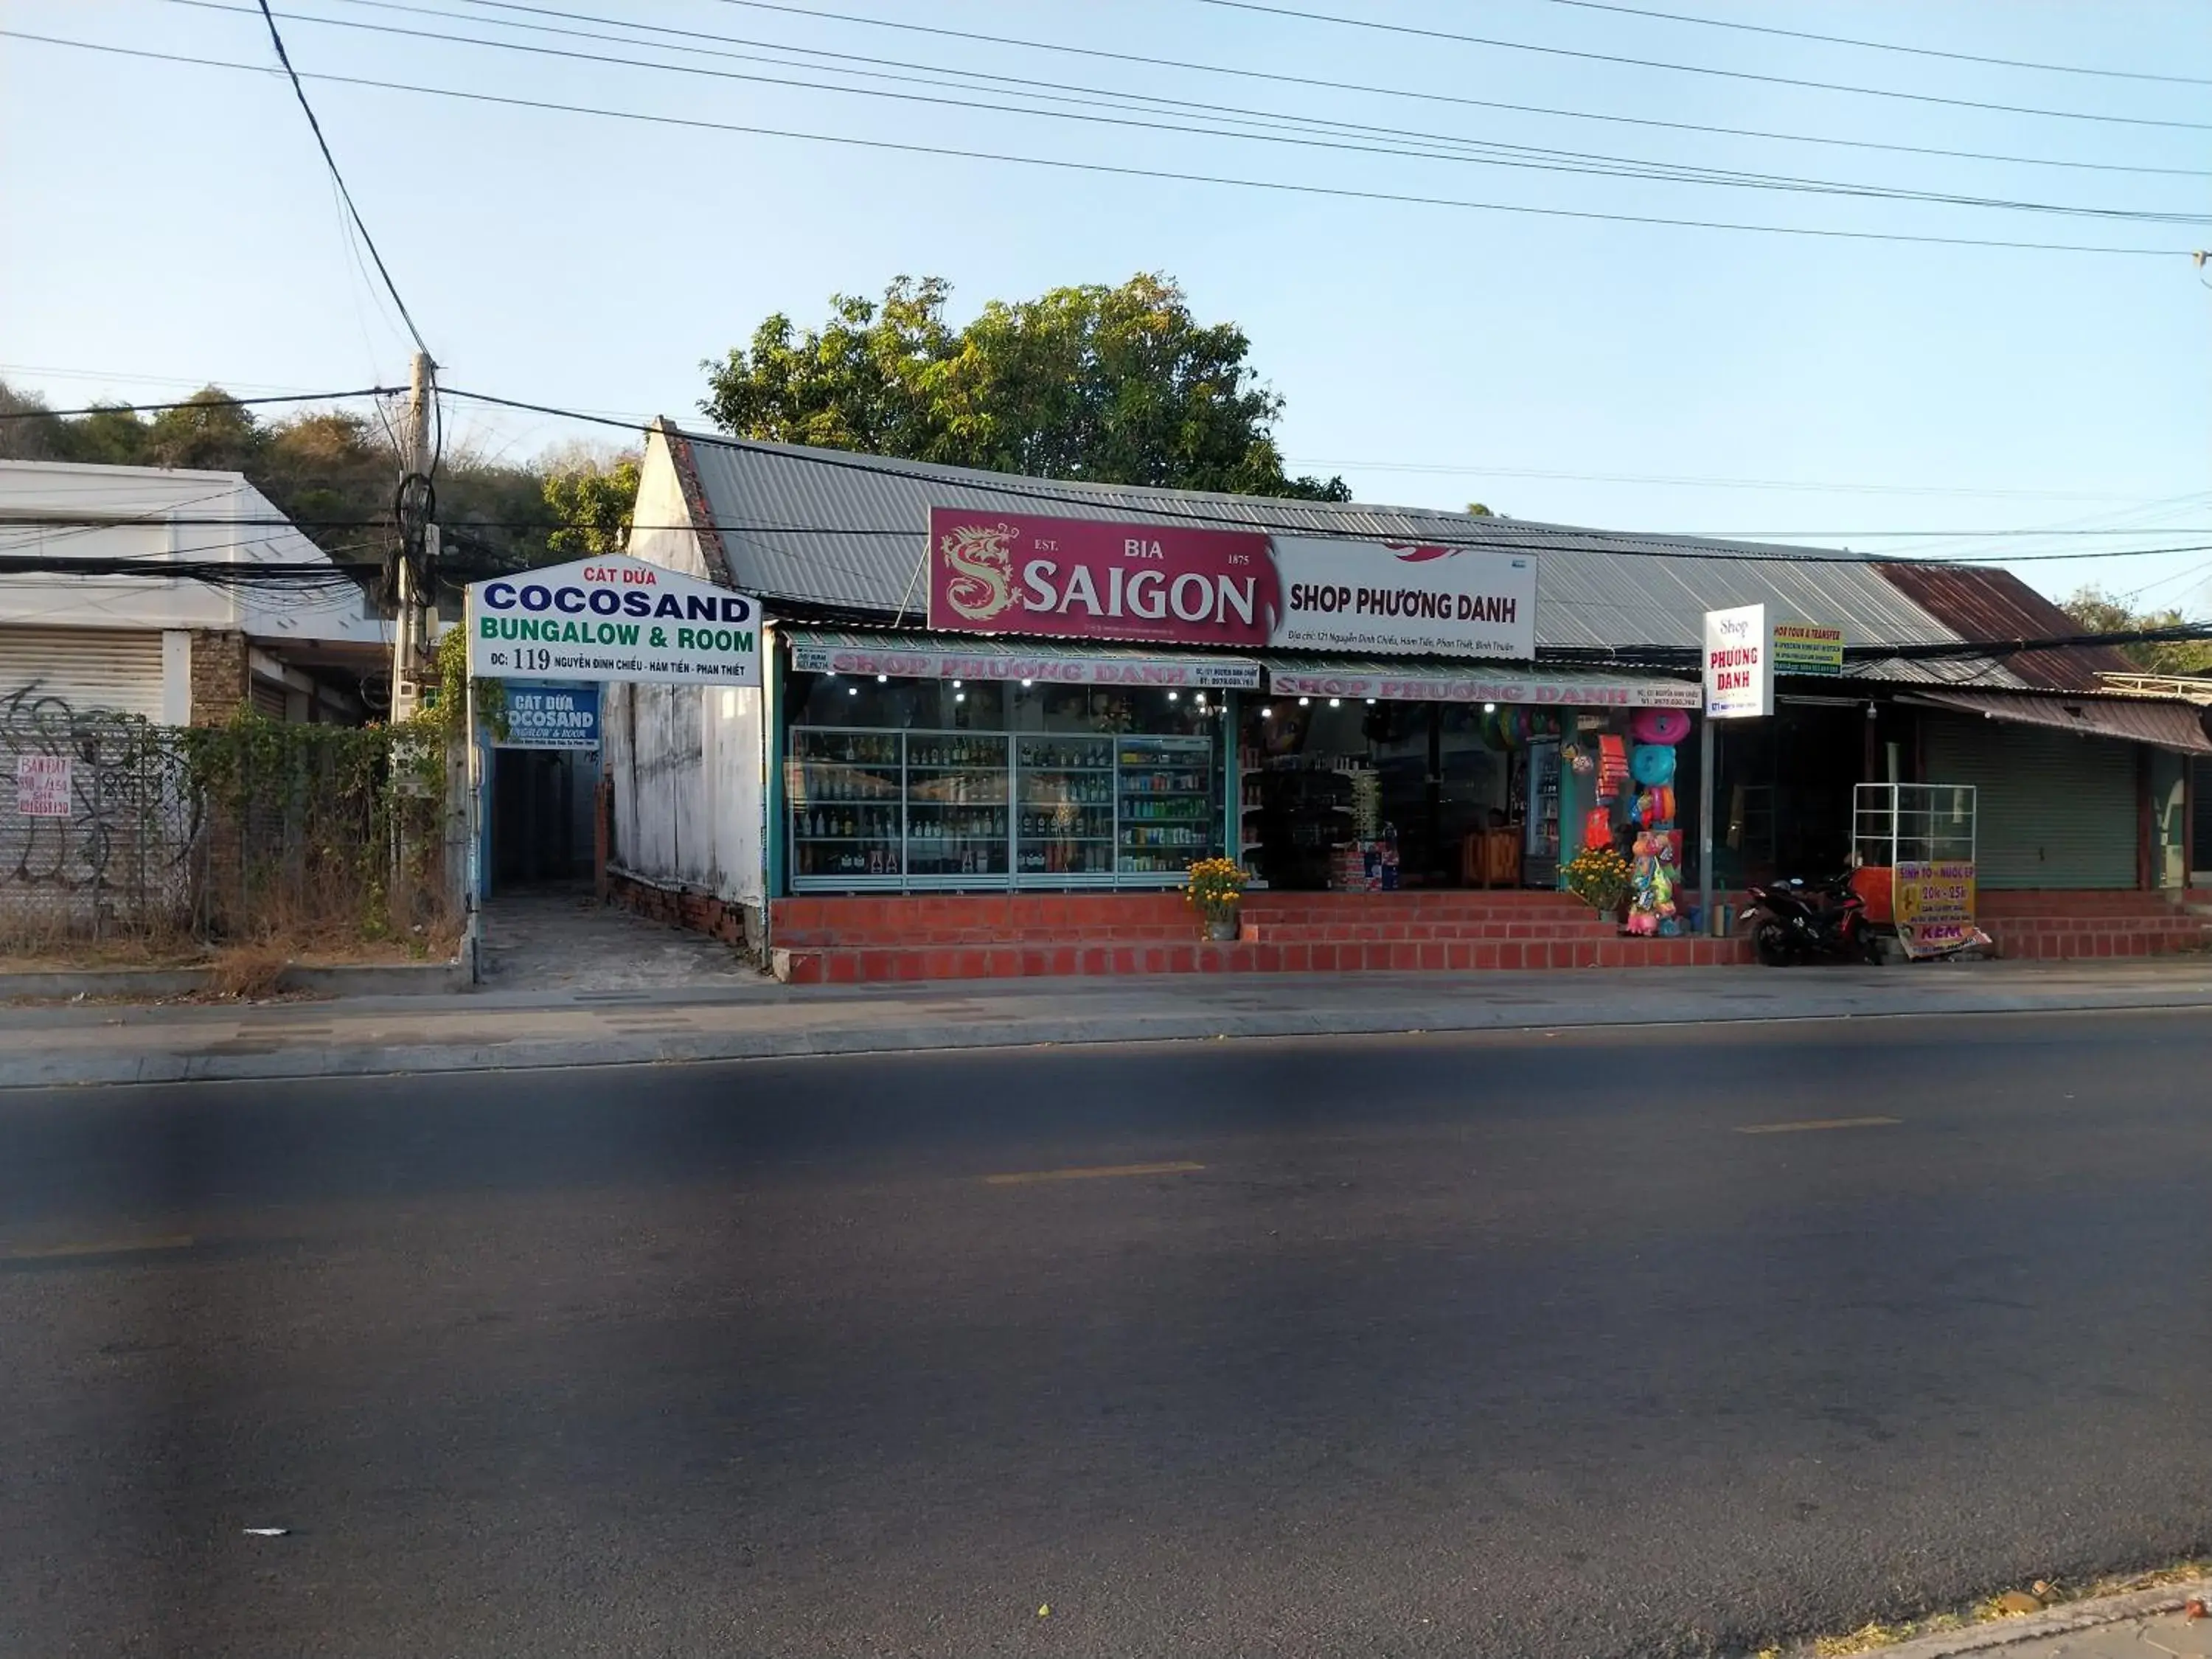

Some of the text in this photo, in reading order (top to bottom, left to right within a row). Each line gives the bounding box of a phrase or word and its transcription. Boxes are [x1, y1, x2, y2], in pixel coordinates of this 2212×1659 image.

[1034, 538, 1164, 559] EST. BIA
[1227, 554, 1250, 566] 1875
[484, 582, 751, 623] COCOSAND
[1022, 559, 1257, 625] SAIGON
[1290, 583, 1516, 623] SHOP PHƯƠNG DANH
[481, 616, 753, 653] BUNGALOW & ROOM
[1720, 617, 1748, 639] Shop
[514, 648, 551, 670] 119
[696, 664, 719, 675] PHAN
[832, 653, 931, 675] SHOP
[1094, 663, 1186, 685] DANH
[1276, 677, 1371, 696] SHOP
[1535, 686, 1631, 704] DANH
[1717, 670, 1750, 690] DANH
[495, 710, 594, 728] OCOSAND
[1921, 925, 1963, 939] KEM
